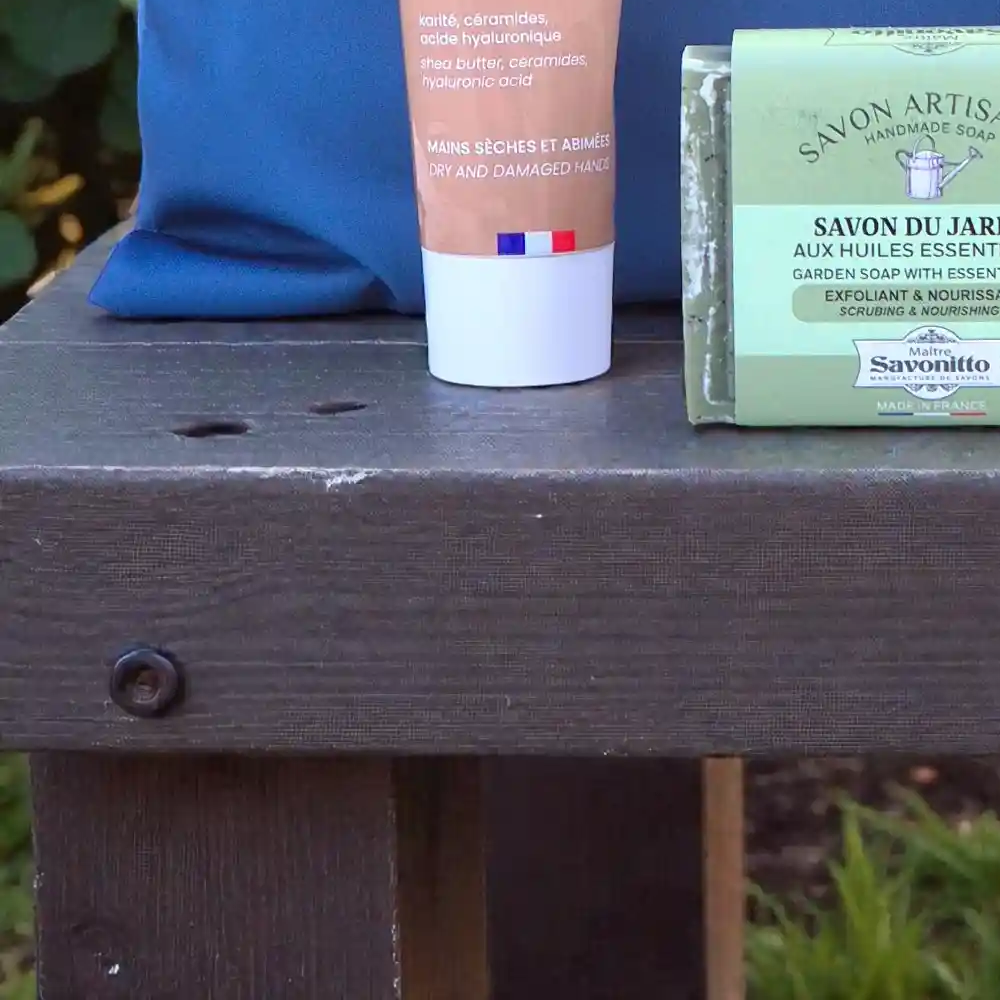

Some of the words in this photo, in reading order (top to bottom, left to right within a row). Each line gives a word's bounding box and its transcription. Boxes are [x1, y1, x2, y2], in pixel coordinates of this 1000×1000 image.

[419, 13, 460, 28] karité,
[464, 12, 548, 27] céramides,
[420, 34, 458, 45] acide
[462, 31, 561, 49] hyaluronique
[420, 58, 451, 70] shea
[456, 57, 505, 71] butter,
[509, 54, 587, 69] ceramides,
[422, 76, 495, 89] hyaluronic
[499, 74, 532, 87] acid
[799, 99, 893, 164] SAVON
[865, 121, 951, 146] HANDMADE
[956, 124, 996, 144] SOAP
[427, 140, 470, 155] MAINS
[475, 138, 536, 155] SÈCHES
[541, 139, 557, 152] ET
[429, 164, 452, 177] DRY
[456, 164, 487, 178] AND
[494, 162, 570, 177] DAMAGED
[574, 157, 610, 173] HANDS
[814, 217, 898, 237] SAVON
[905, 217, 940, 236] DU
[793, 243, 833, 258] AUX
[840, 243, 914, 258] HUILES
[793, 268, 856, 280] GARDEN
[860, 268, 901, 280] SOAP
[904, 268, 943, 279] WITH
[825, 290, 909, 302] EXFOLIANT
[913, 290, 923, 301] &
[840, 306, 905, 316] SCRUBING
[909, 307, 916, 316] &
[921, 306, 1000, 316] NOURISHING
[909, 346, 952, 357] Maître
[870, 356, 990, 373] Savonitto
[877, 400, 914, 410] MADE
[917, 402, 930, 410] IN
[933, 401, 986, 410] FRANCE
